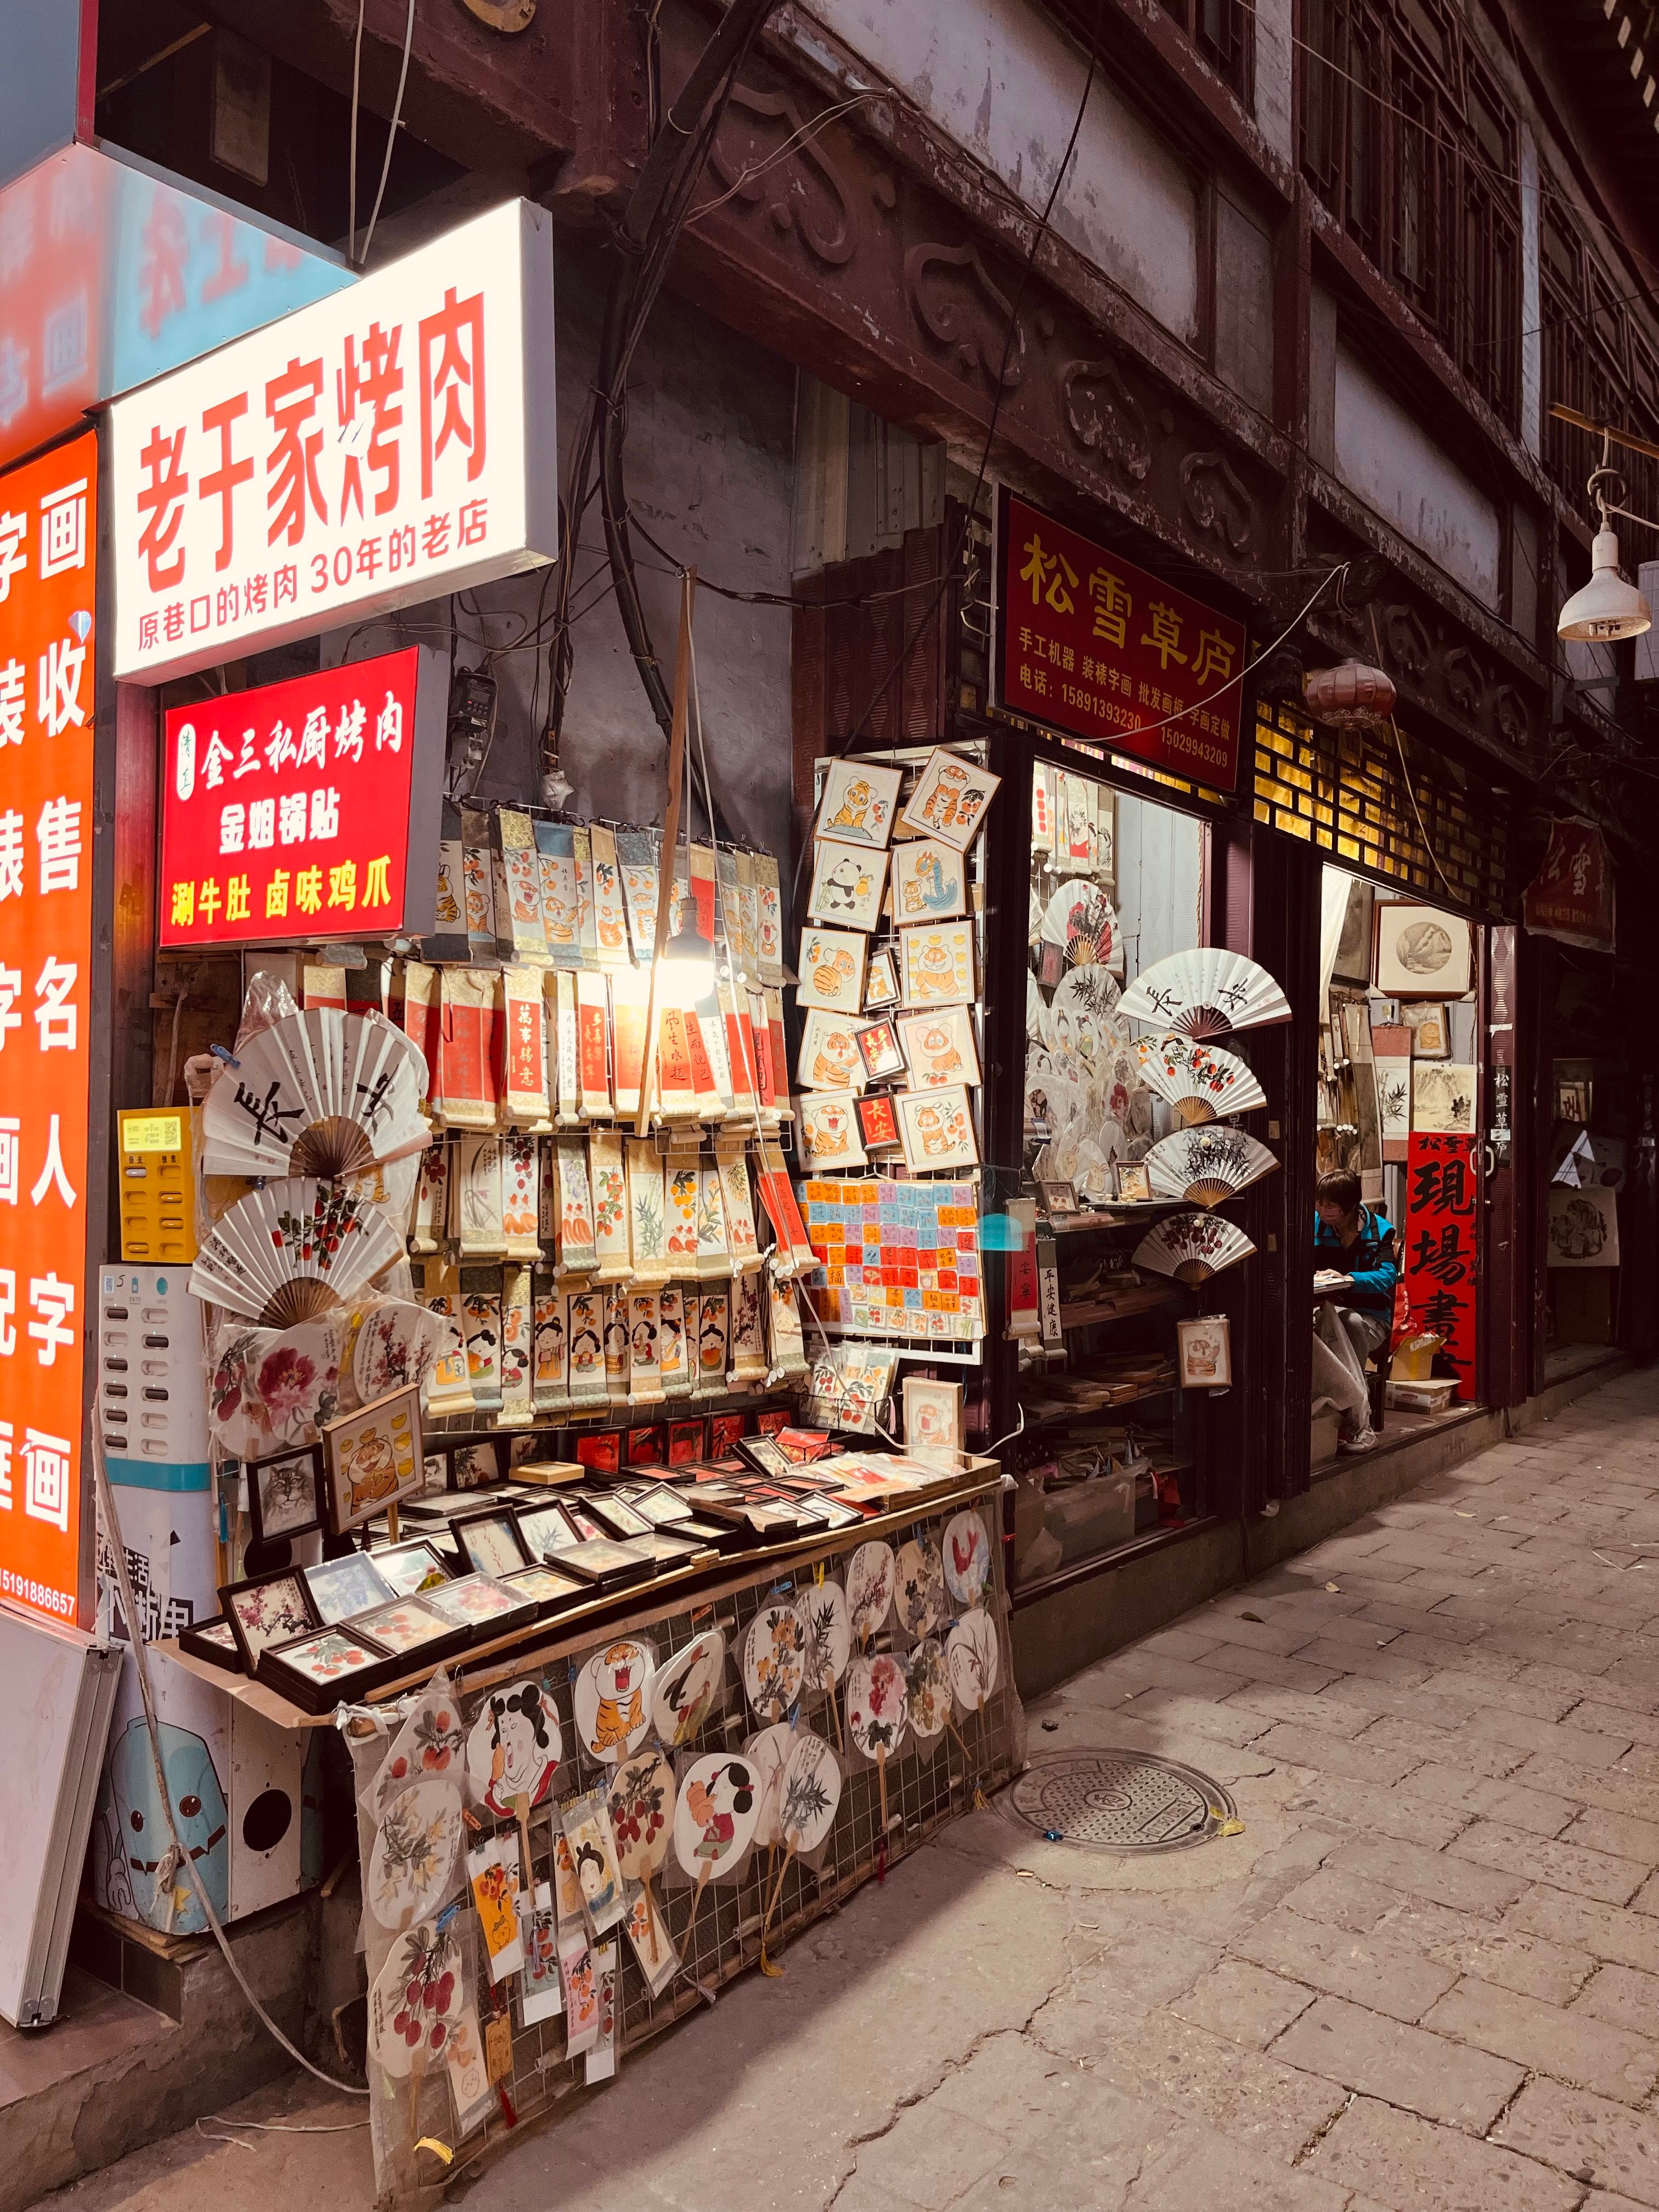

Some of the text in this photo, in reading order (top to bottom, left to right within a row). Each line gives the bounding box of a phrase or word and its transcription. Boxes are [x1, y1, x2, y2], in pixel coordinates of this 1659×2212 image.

[138, 498, 488, 651] 原巷口的烤肉 30年的老店
[1019, 533, 1235, 686] 松雪草庐
[1019, 626, 1231, 741] 手工机器 装裱字画 批发画框 字画定做
[1062, 683, 1142, 731] 15891393230
[201, 690, 403, 790] 金三私厨烤肉
[1160, 725, 1228, 768] 15029943209
[219, 787, 341, 854] 金姐锅贴
[171, 854, 392, 926] 涮牛肚 卤味鸡爪
[517, 1003, 534, 1087] 萬事勝意
[866, 1099, 893, 1142] 長安
[829, 1269, 842, 1284] 福
[1044, 1268, 1058, 1338] 平安健康
